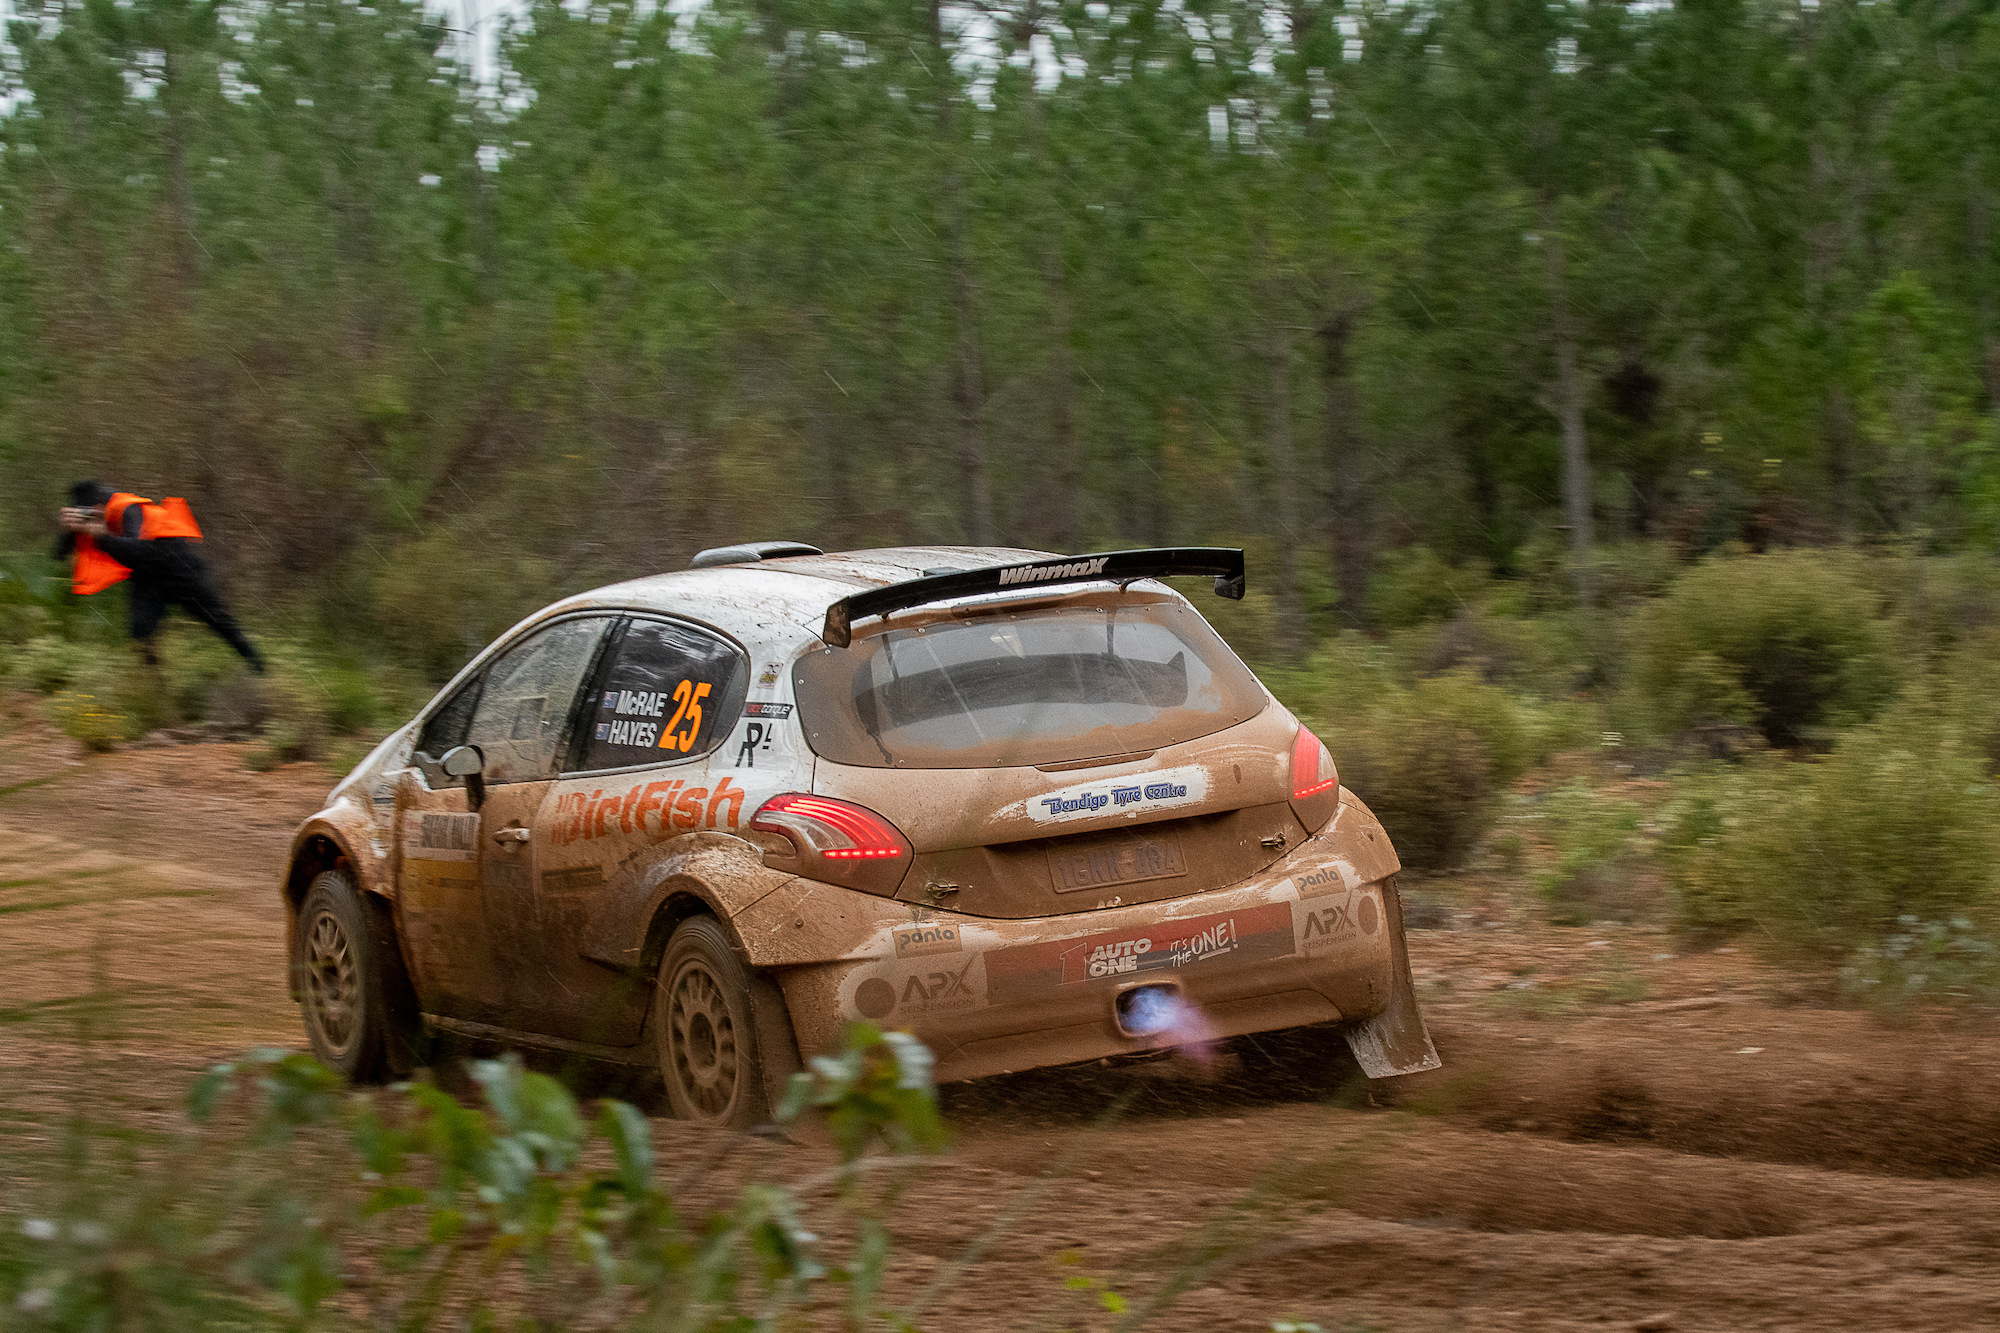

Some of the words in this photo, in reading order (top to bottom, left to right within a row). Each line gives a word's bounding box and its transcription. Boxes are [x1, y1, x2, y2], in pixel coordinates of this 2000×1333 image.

[615, 690, 668, 718] McRAE
[657, 679, 713, 753] 25
[607, 720, 658, 748] HAYES
[551, 777, 745, 846] DirtFish
[1041, 792, 1109, 814] Bendigo
[1111, 786, 1142, 806] Tyre
[1144, 782, 1188, 800] Centre
[1298, 869, 1339, 891] panta
[1303, 892, 1356, 939] APX
[900, 927, 956, 950] panta
[1089, 938, 1152, 963] AUTO
[1170, 937, 1188, 952] IT'S
[1191, 918, 1239, 955] ONE!
[1303, 931, 1357, 949] SUSPENSION
[1089, 955, 1138, 977] ONE
[1169, 951, 1192, 967] THE
[902, 951, 978, 1002] APX
